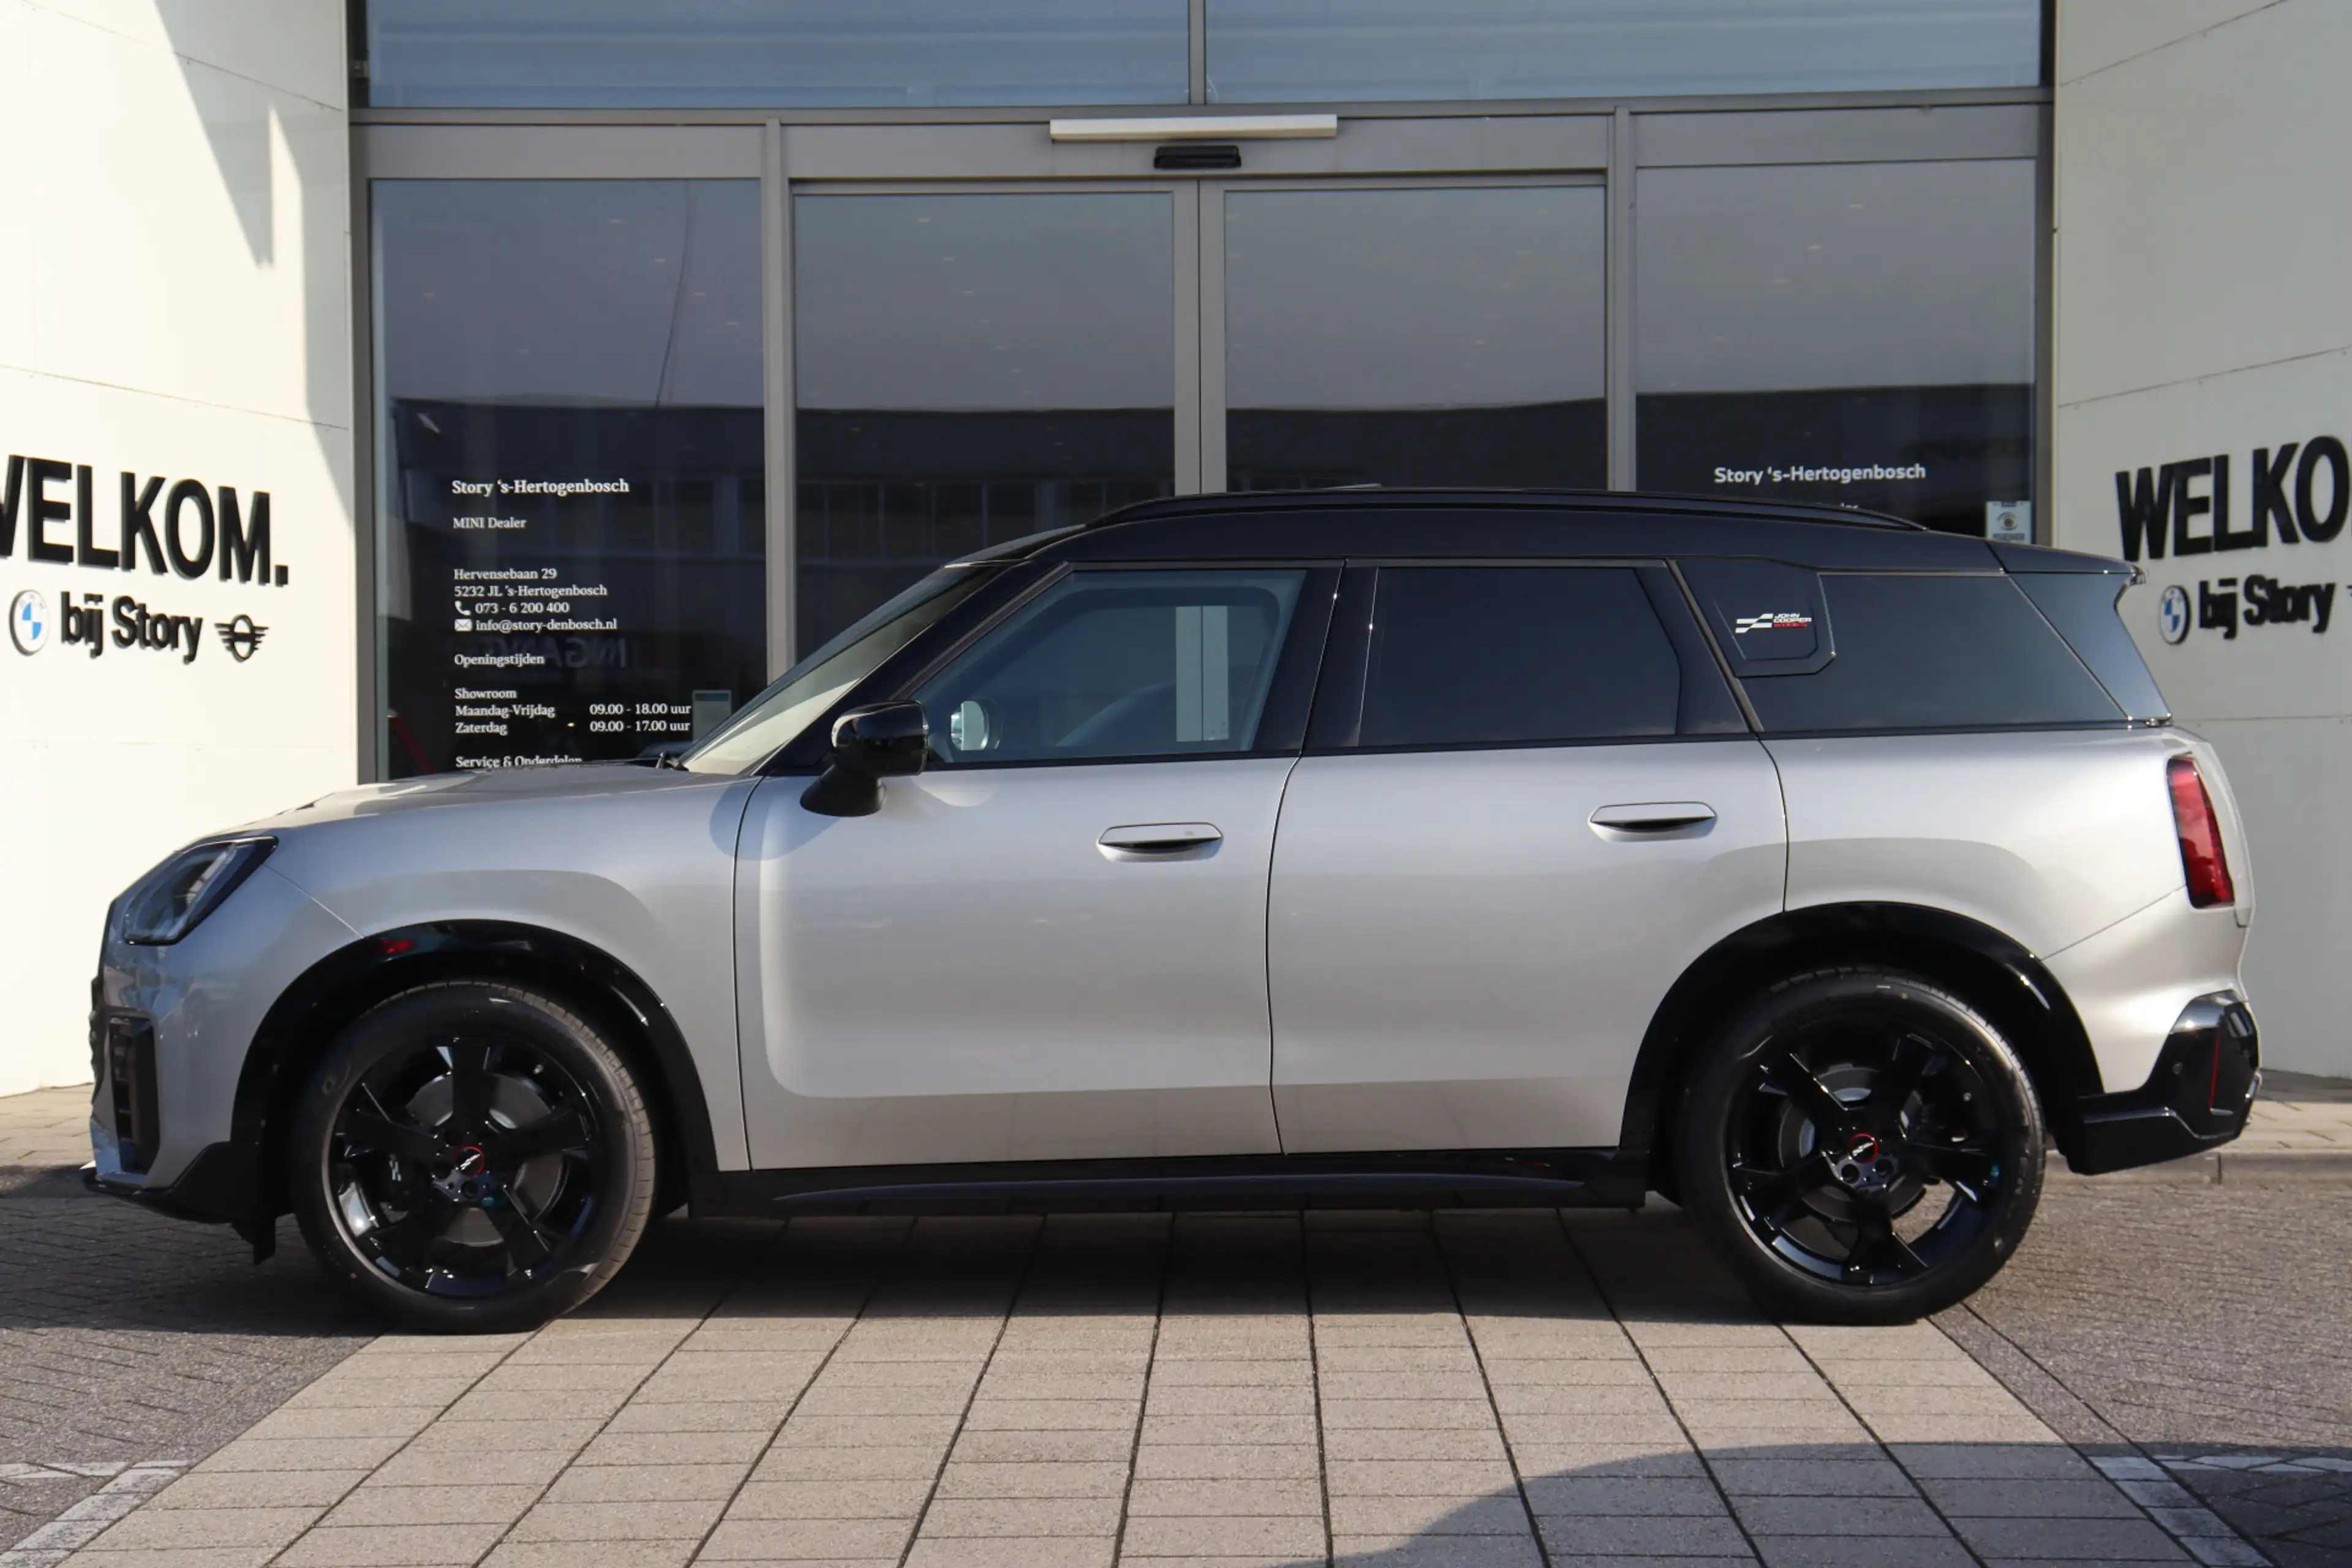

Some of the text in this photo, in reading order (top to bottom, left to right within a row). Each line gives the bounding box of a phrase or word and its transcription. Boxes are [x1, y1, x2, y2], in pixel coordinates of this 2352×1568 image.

[1714, 464, 1926, 485] Story 's-Hertogenbosch
[452, 478, 629, 497] Story 's-Hertogenbosch
[2115, 435, 2352, 562] WELKO
[453, 517, 527, 529] MINI Dealer
[454, 568, 557, 579] Hervensebaan 29
[454, 584, 608, 598] 5232 JL 's-Hertogenbosch
[475, 603, 499, 614] 073
[509, 603, 518, 613] 6
[521, 603, 544, 613] 200
[546, 602, 570, 613] 400
[2199, 575, 2336, 639] bij Story
[61, 591, 203, 664] bij Story
[476, 618, 617, 633] info@story-denbosch.nl
[454, 653, 545, 668] Openingstijden
[455, 688, 517, 699] Showroom
[456, 704, 556, 719] Maandag-Vrijdag
[590, 704, 624, 715] 09.00
[635, 703, 668, 714] 18.00
[671, 706, 692, 714] uur
[456, 721, 508, 736] Zaterdag
[590, 721, 624, 732] 09.00
[636, 720, 667, 731] 17.00
[670, 723, 691, 731] uur
[456, 756, 500, 767] Service
